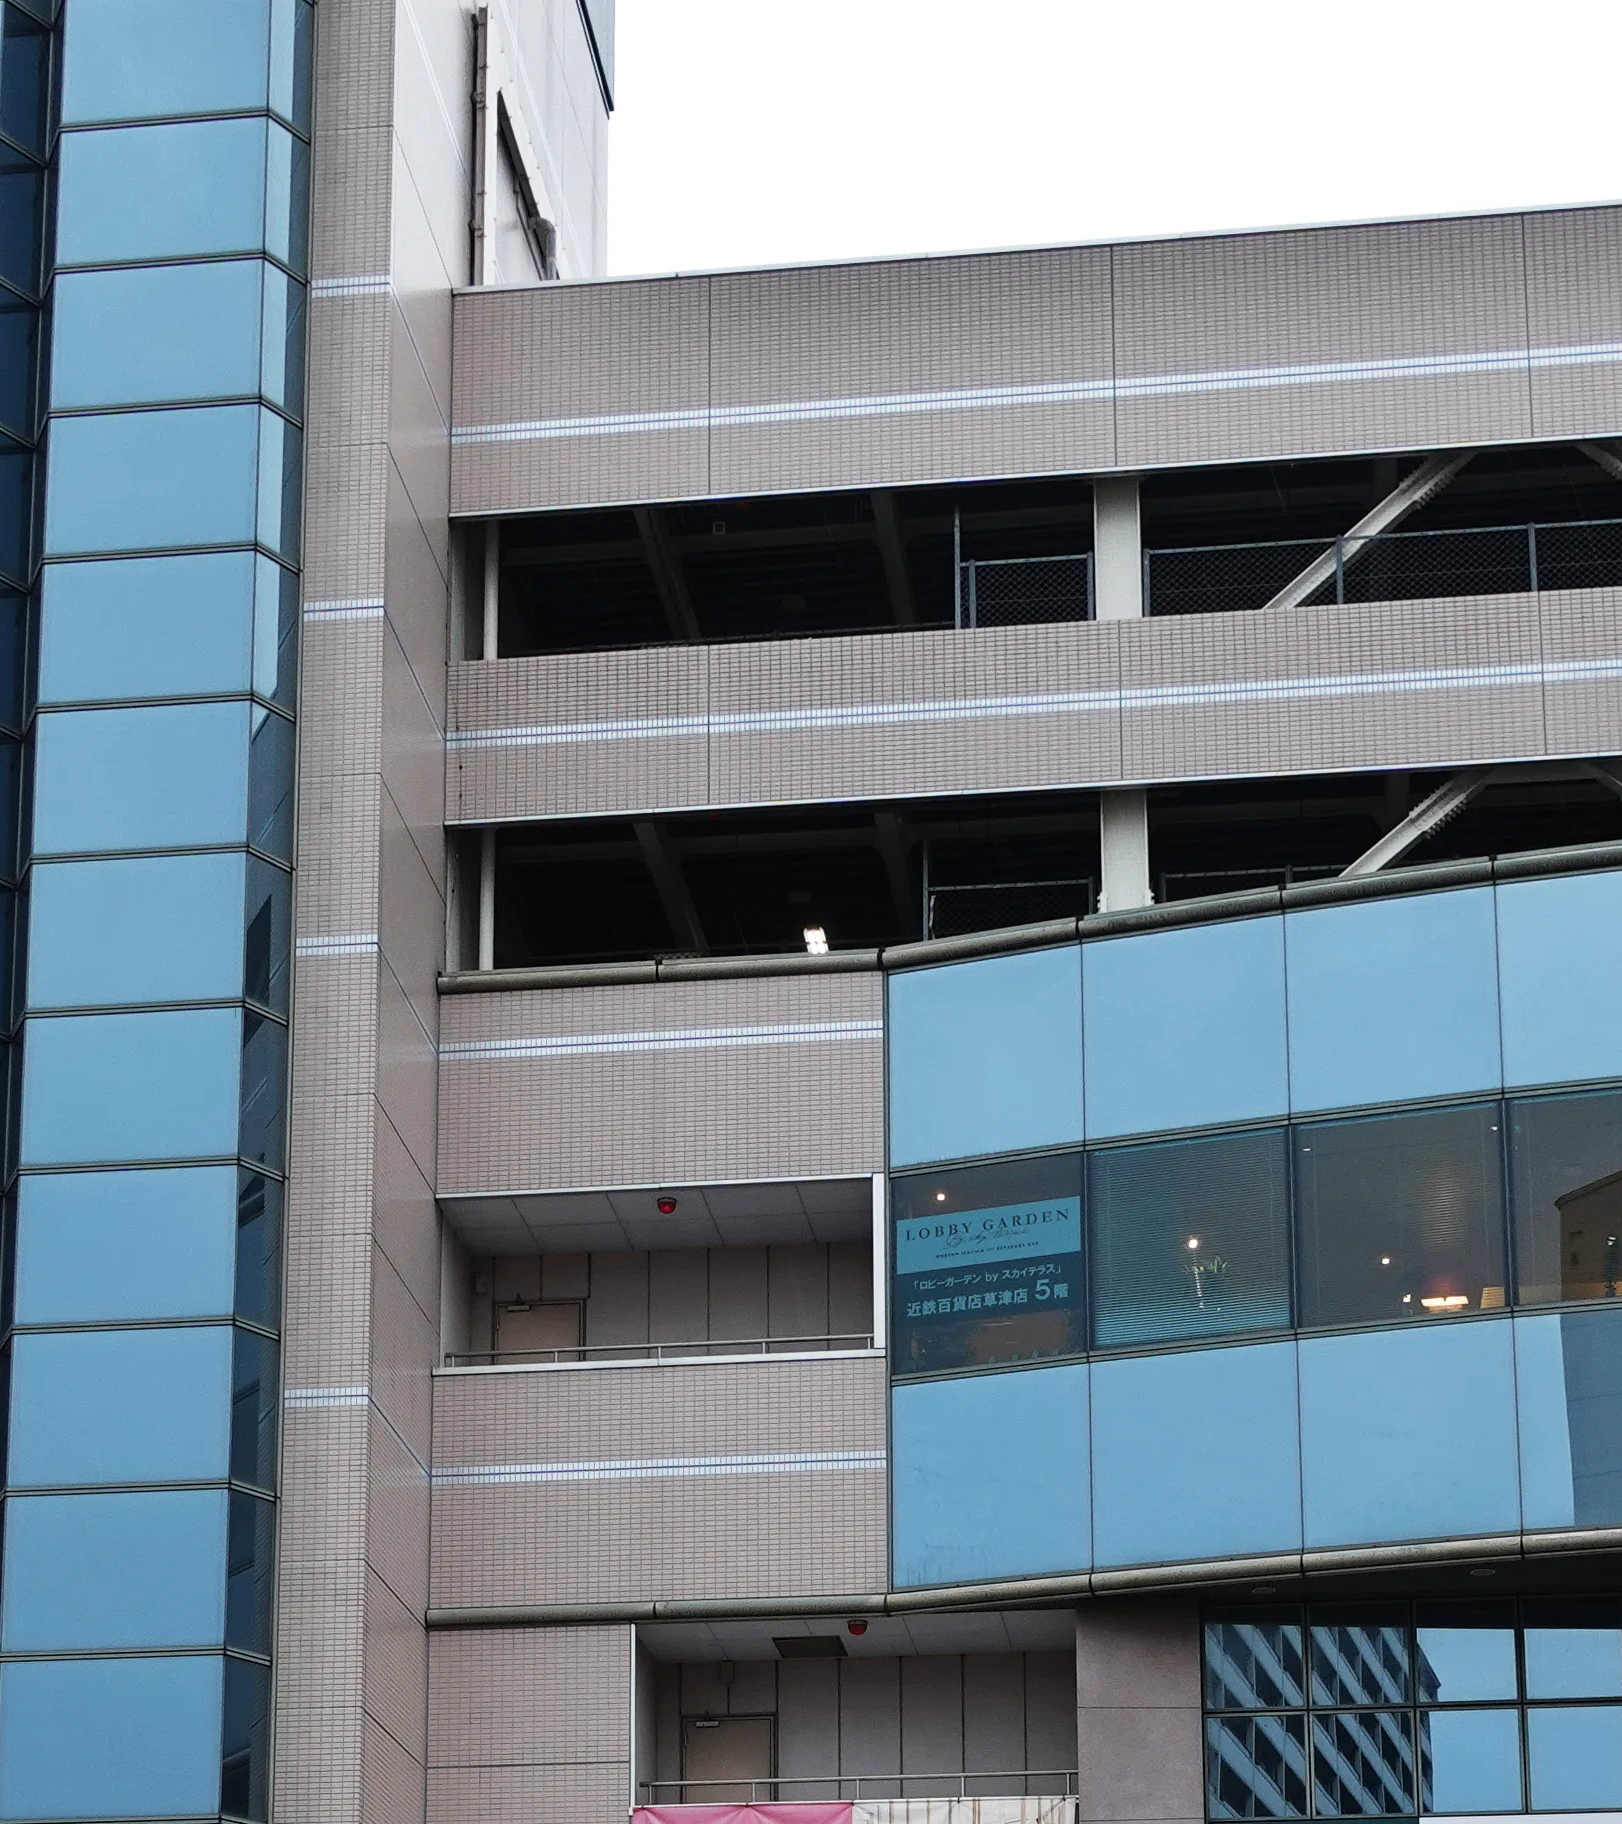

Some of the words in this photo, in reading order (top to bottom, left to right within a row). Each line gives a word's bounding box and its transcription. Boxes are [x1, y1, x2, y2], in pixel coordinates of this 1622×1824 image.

[905, 1221, 972, 1241] LOBBY
[982, 1208, 1070, 1230] GARDEN
[985, 1271, 999, 1283] by
[906, 1288, 1028, 1318] 近鉄百貨店草津店
